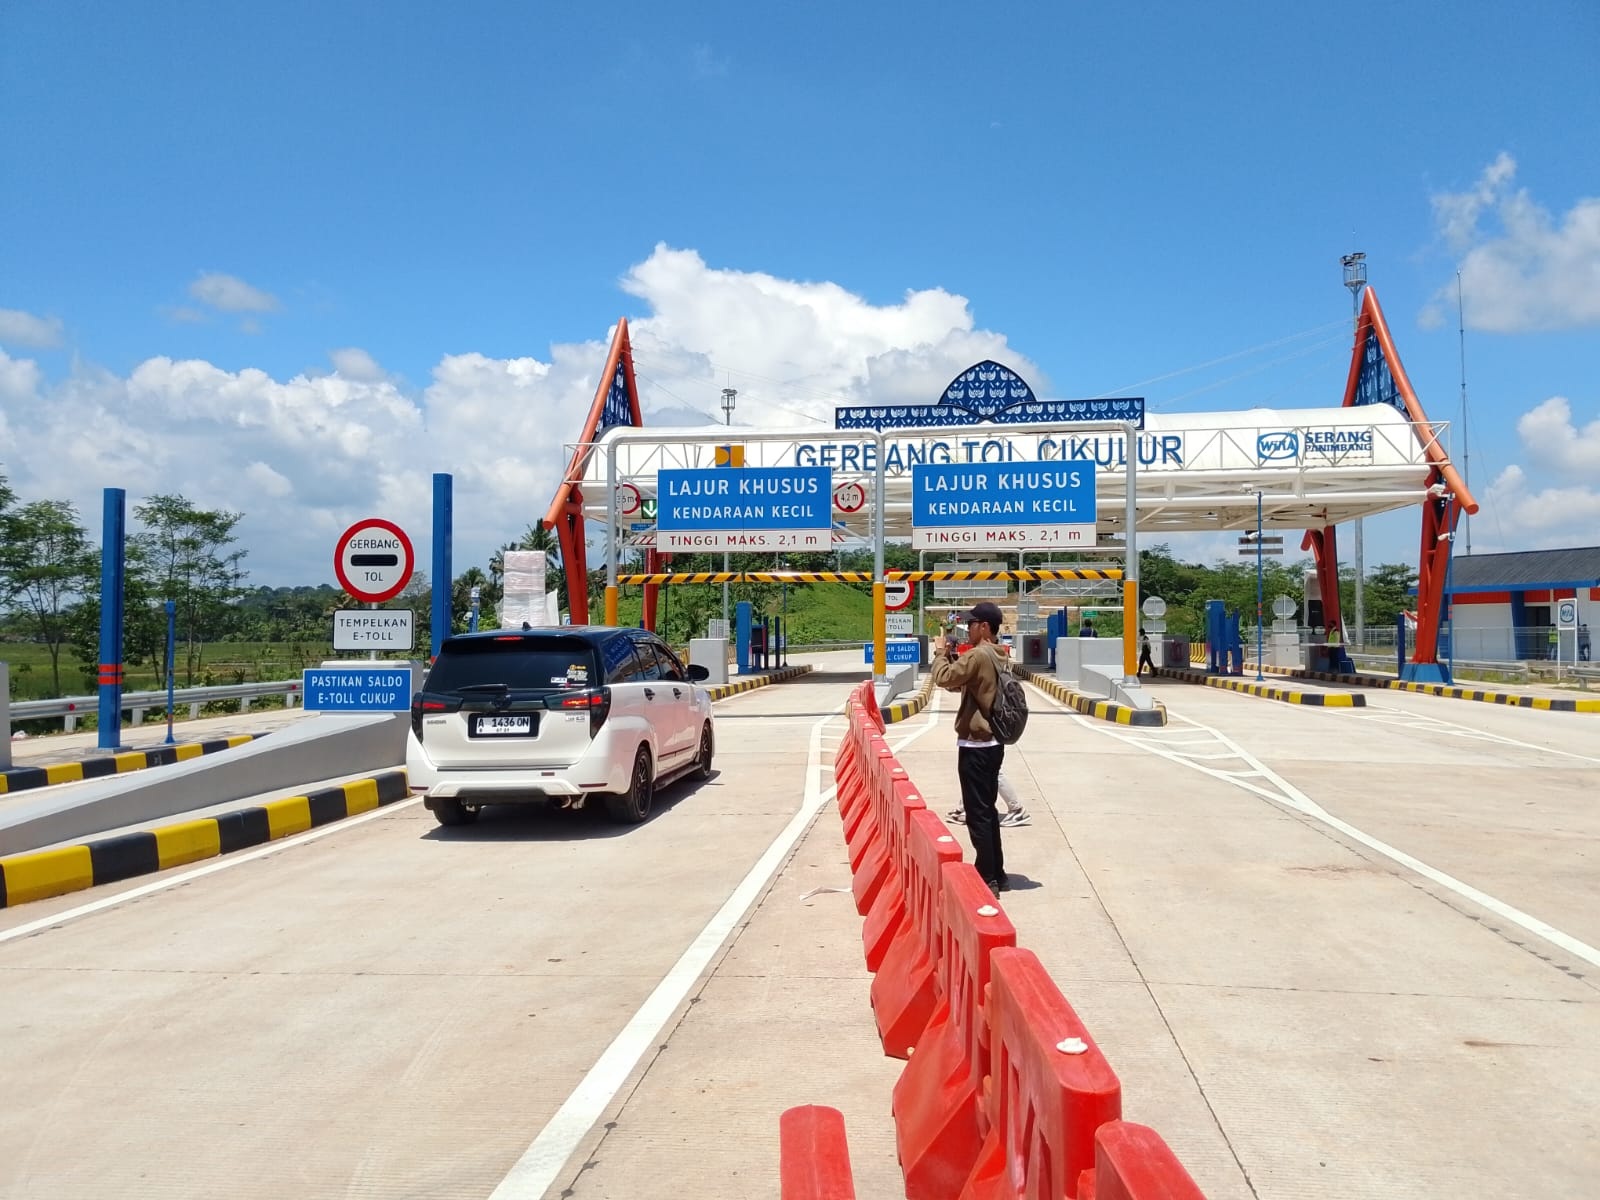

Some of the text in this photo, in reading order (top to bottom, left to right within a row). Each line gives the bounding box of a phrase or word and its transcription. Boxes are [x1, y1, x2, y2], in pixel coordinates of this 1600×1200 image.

[1305, 431, 1372, 443] SERANG
[1305, 443, 1372, 452] PANIMBANG
[797, 442, 950, 472] GERBANG
[1038, 436, 1183, 466] CIKULUR
[670, 478, 818, 496] LAJUR KHUSUS
[925, 472, 1081, 492] LAJUR KHUSUS
[674, 505, 814, 519] KENDARAAN KECIL
[929, 499, 1077, 515] KENDARAAN KECIL
[670, 535, 817, 546] TINGGI MAKS. 2,1 m
[926, 530, 1081, 543] TINGGI MAKS. 2,1 m
[350, 539, 399, 549] GERBANG
[364, 572, 384, 581] TOL
[339, 619, 407, 627] TEMPELKAN
[353, 632, 393, 640] E-TOLL
[312, 676, 402, 687] PASTIKAN SALDO
[318, 693, 396, 704] E-TOLL CUKUP
[478, 718, 484, 727] A
[492, 718, 515, 727] 1436
